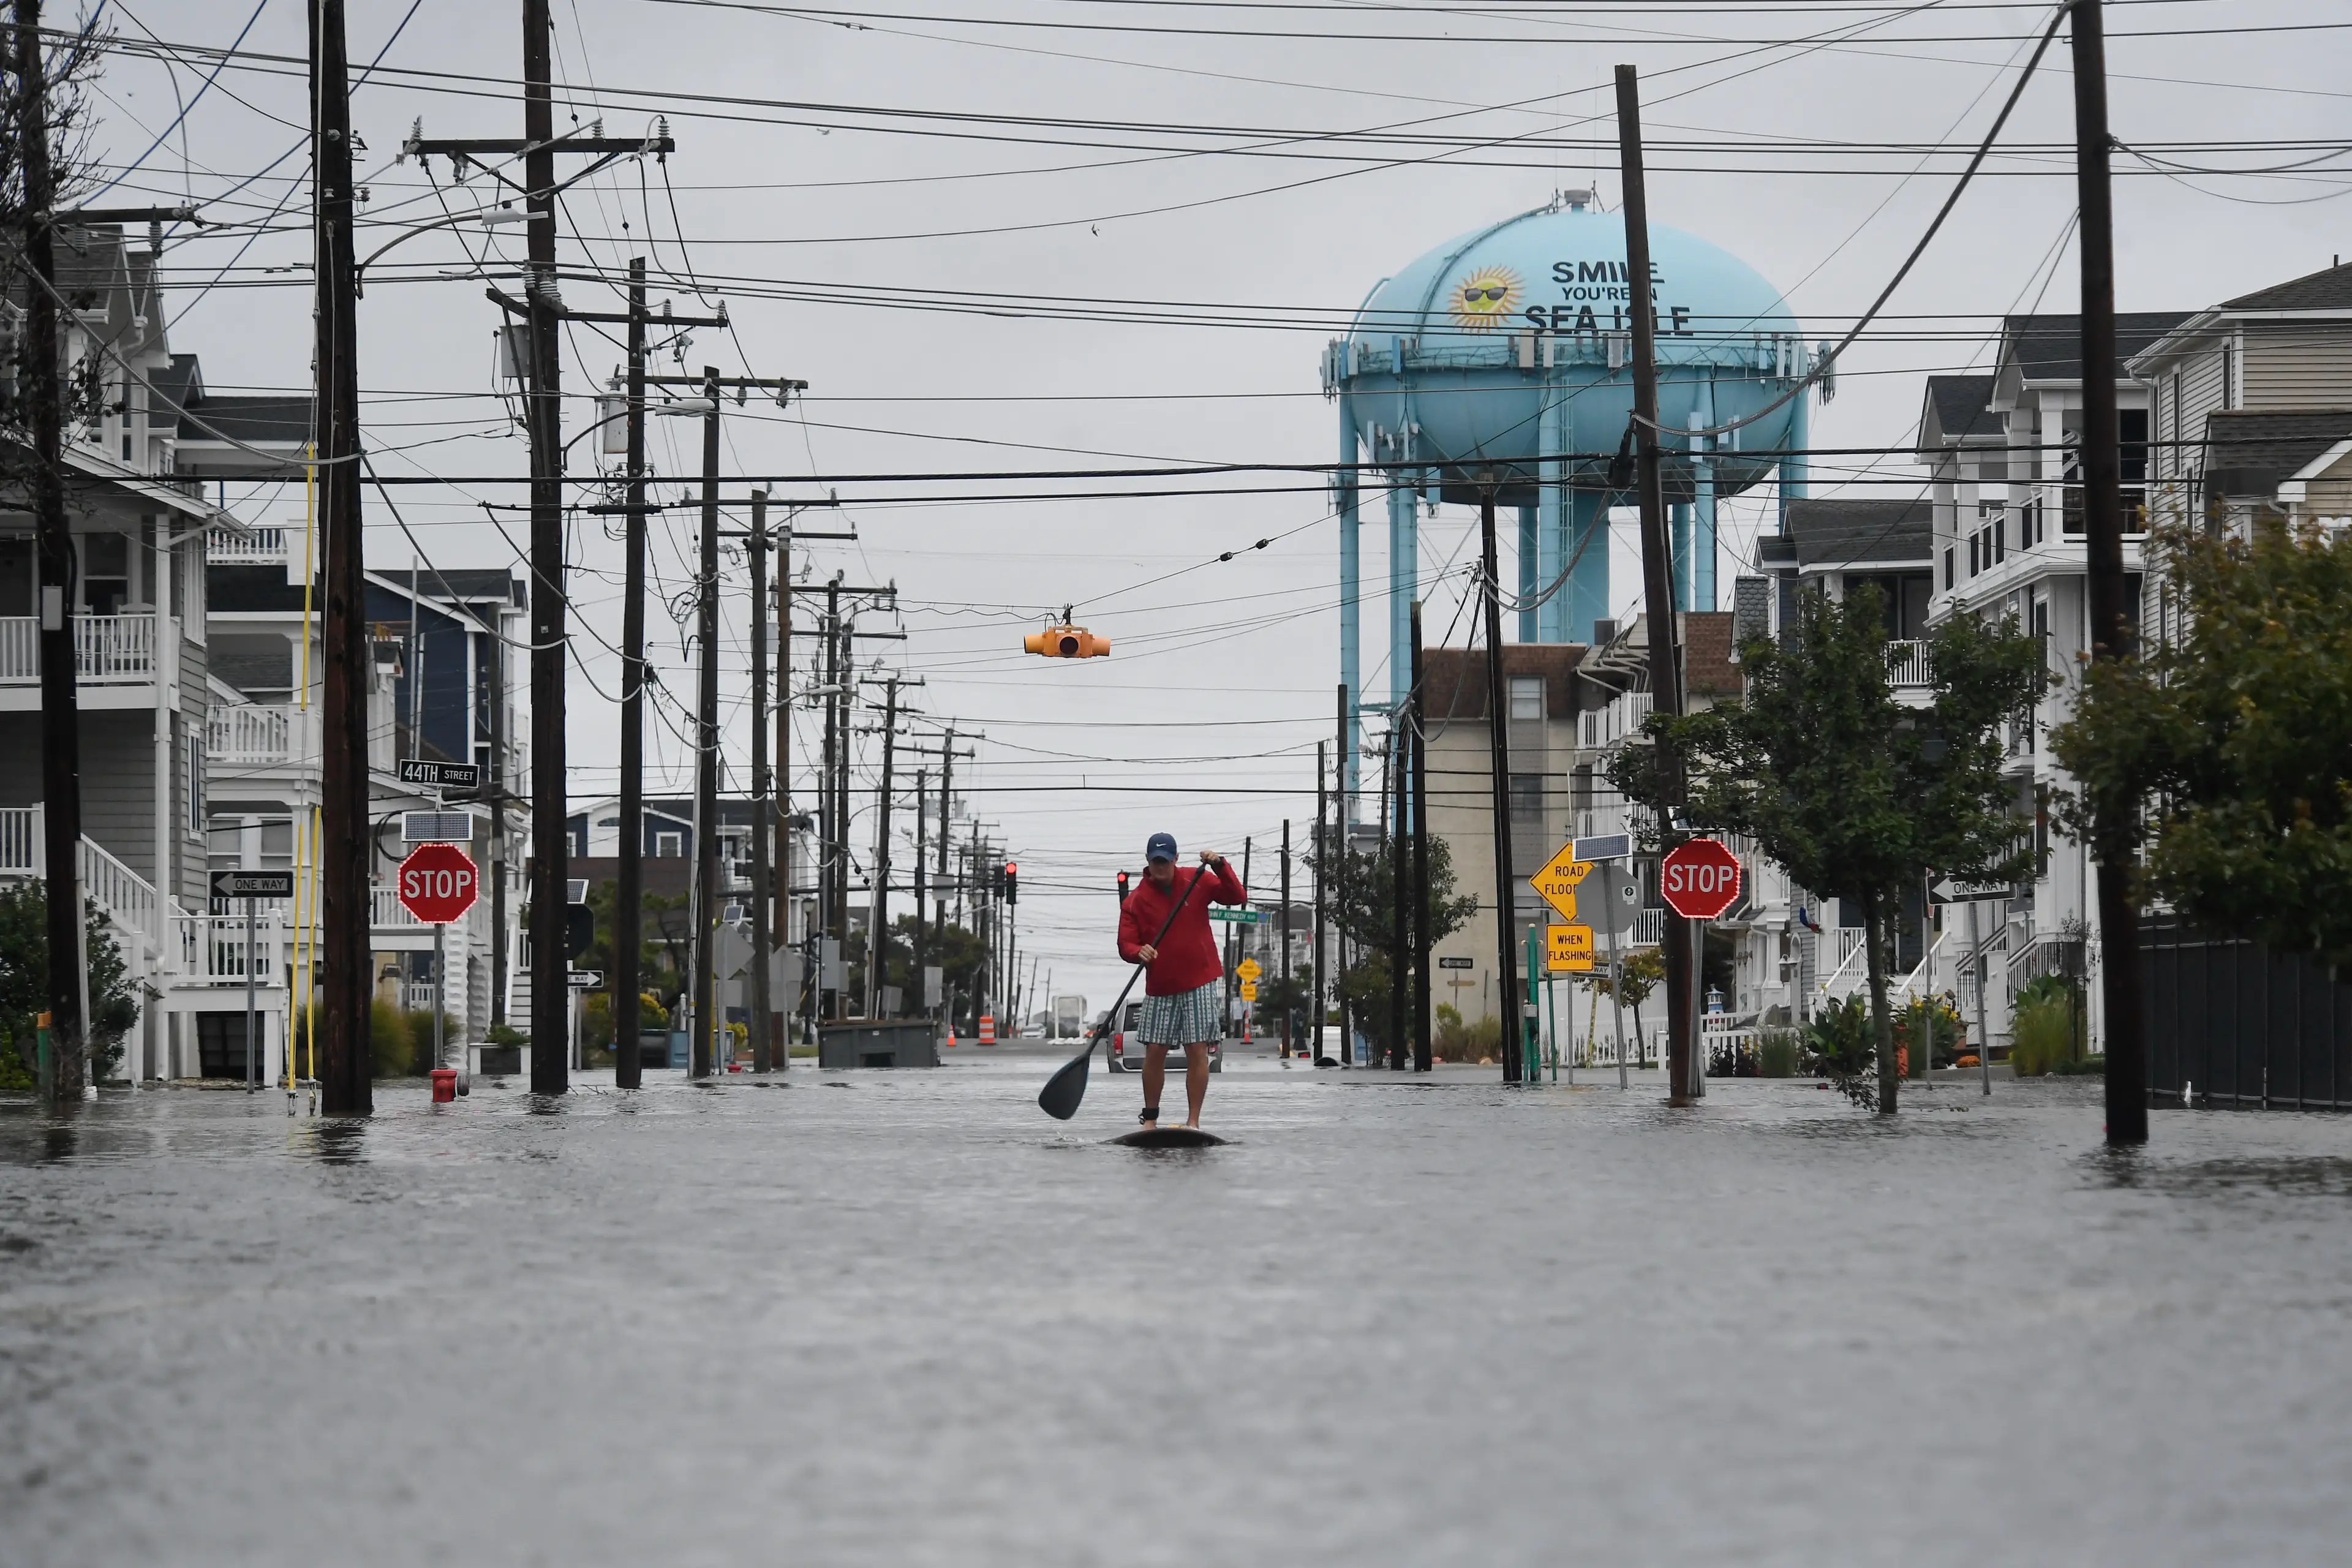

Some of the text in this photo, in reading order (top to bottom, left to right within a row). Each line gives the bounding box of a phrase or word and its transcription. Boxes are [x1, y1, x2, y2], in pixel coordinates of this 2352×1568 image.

[404, 763, 474, 782] 44TH STREET
[1555, 865, 1584, 877] ROAD
[1668, 864, 1734, 892] STOP
[235, 880, 284, 889] ONE WAY
[404, 870, 472, 899] STOP
[1557, 935, 1583, 944] WHEN
[1548, 951, 1591, 961] FLASHING
